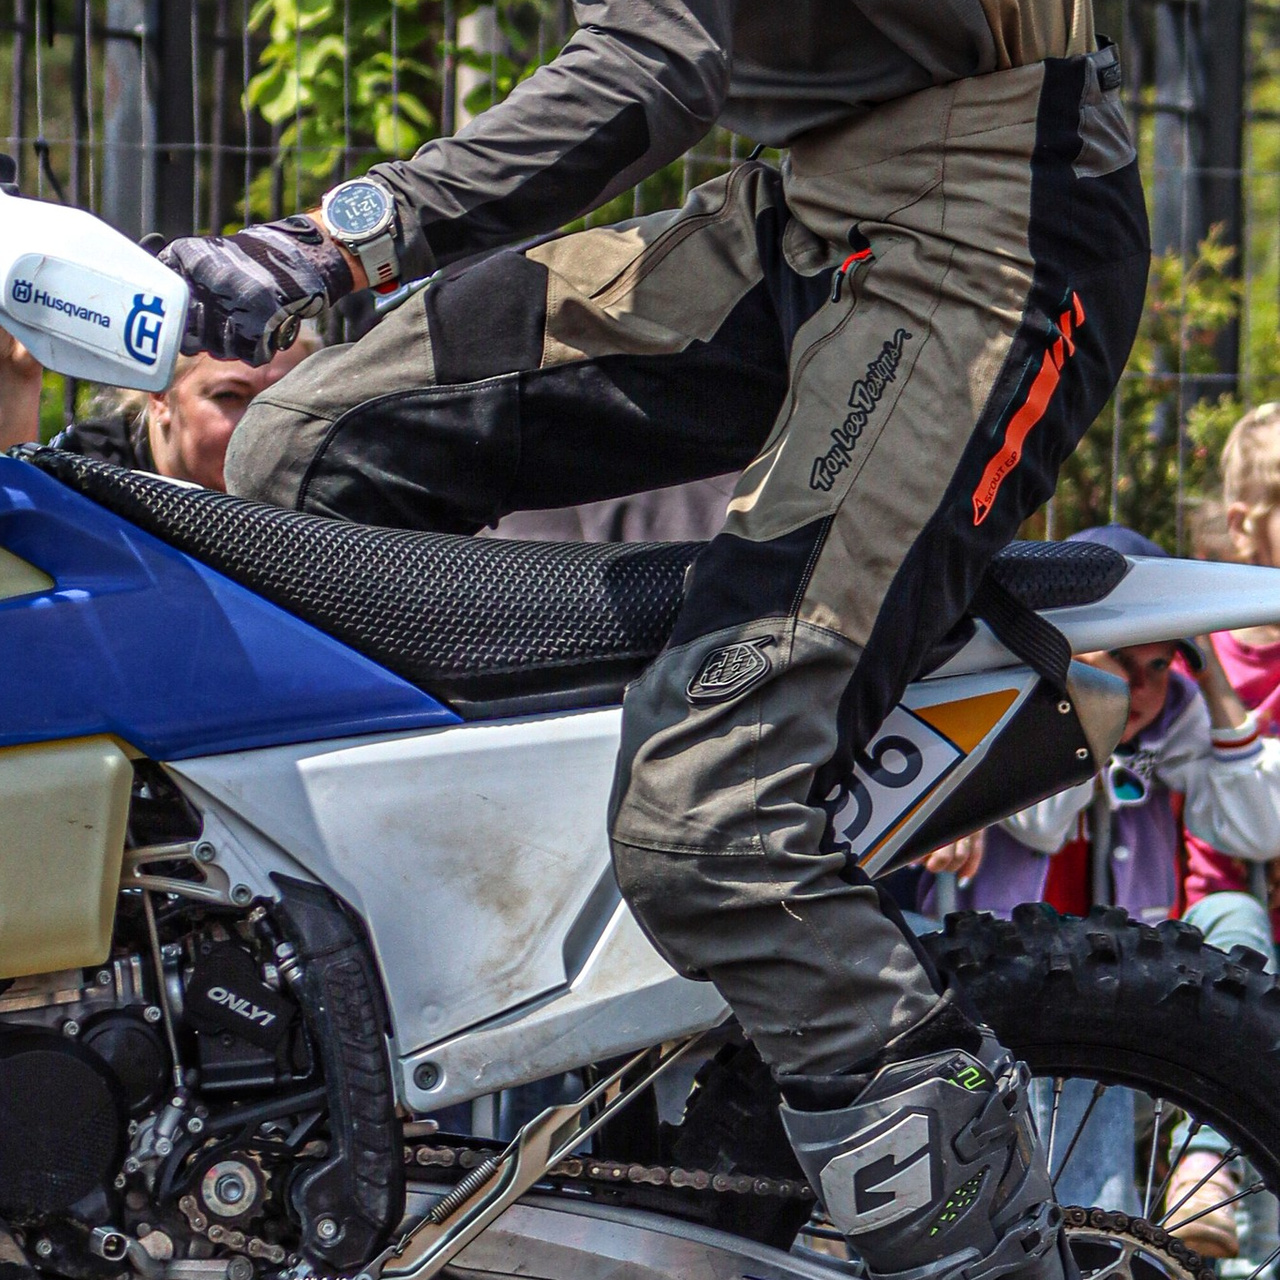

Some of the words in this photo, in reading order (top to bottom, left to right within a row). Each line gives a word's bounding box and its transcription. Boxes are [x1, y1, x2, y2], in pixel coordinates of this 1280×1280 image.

[33, 288, 111, 328] Husqvarna
[984, 466, 1006, 505] SCOUT
[207, 985, 277, 1028] ONLY1
